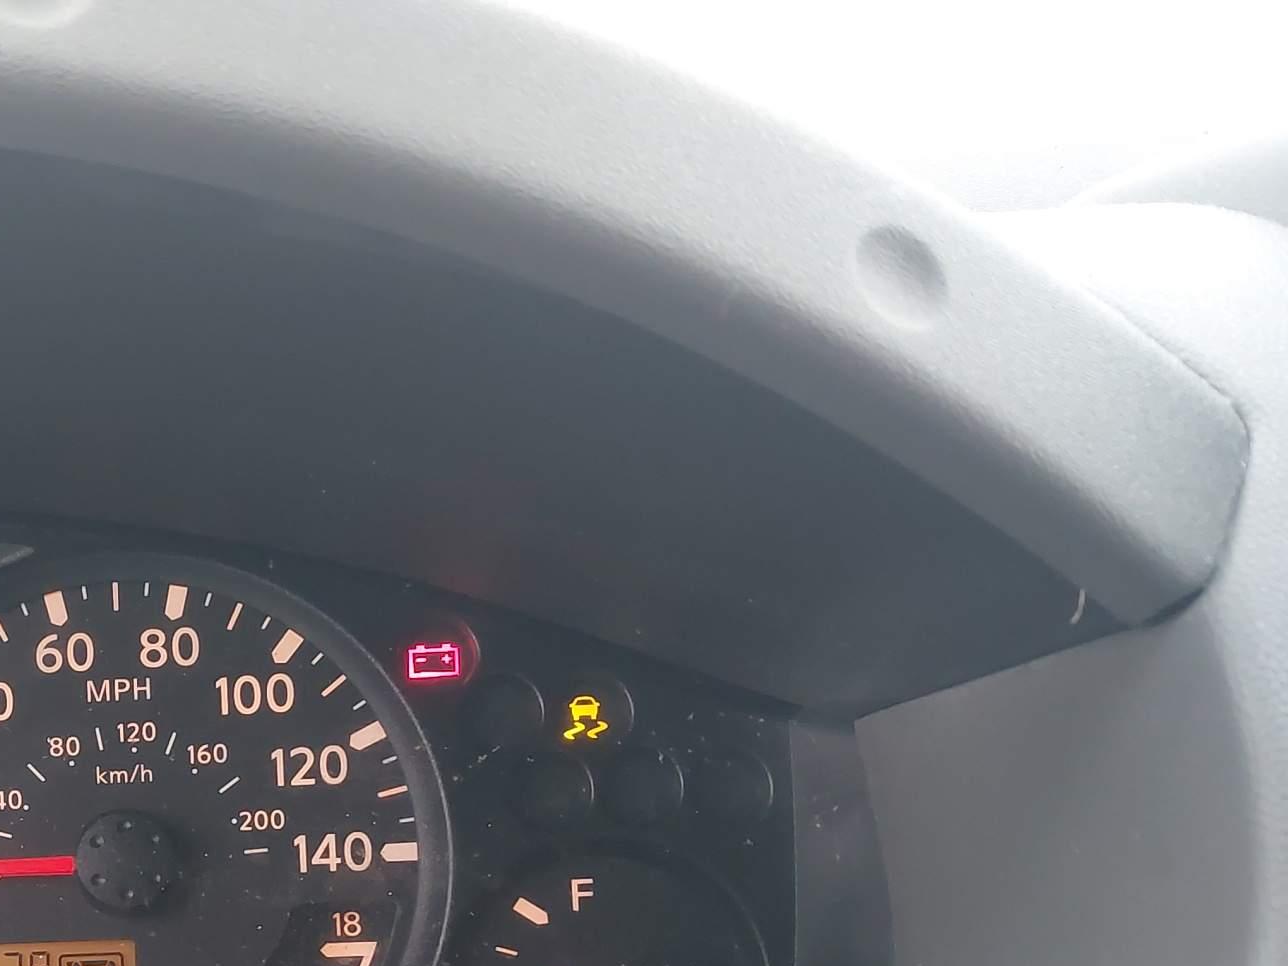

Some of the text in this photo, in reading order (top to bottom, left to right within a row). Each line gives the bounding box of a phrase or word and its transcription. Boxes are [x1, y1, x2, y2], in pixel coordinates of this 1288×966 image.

[35, 632, 94, 674] 60
[139, 627, 200, 668] 80
[85, 677, 152, 704] MPH
[215, 673, 295, 716] 100
[116, 721, 157, 743] 120
[49, 736, 80, 757] 80
[186, 743, 228, 765] 160
[95, 764, 154, 784] km/h
[271, 745, 348, 787] 120
[239, 809, 286, 831] 200
[293, 831, 372, 873] 140
[570, 878, 594, 912] F
[332, 911, 363, 937] 18
